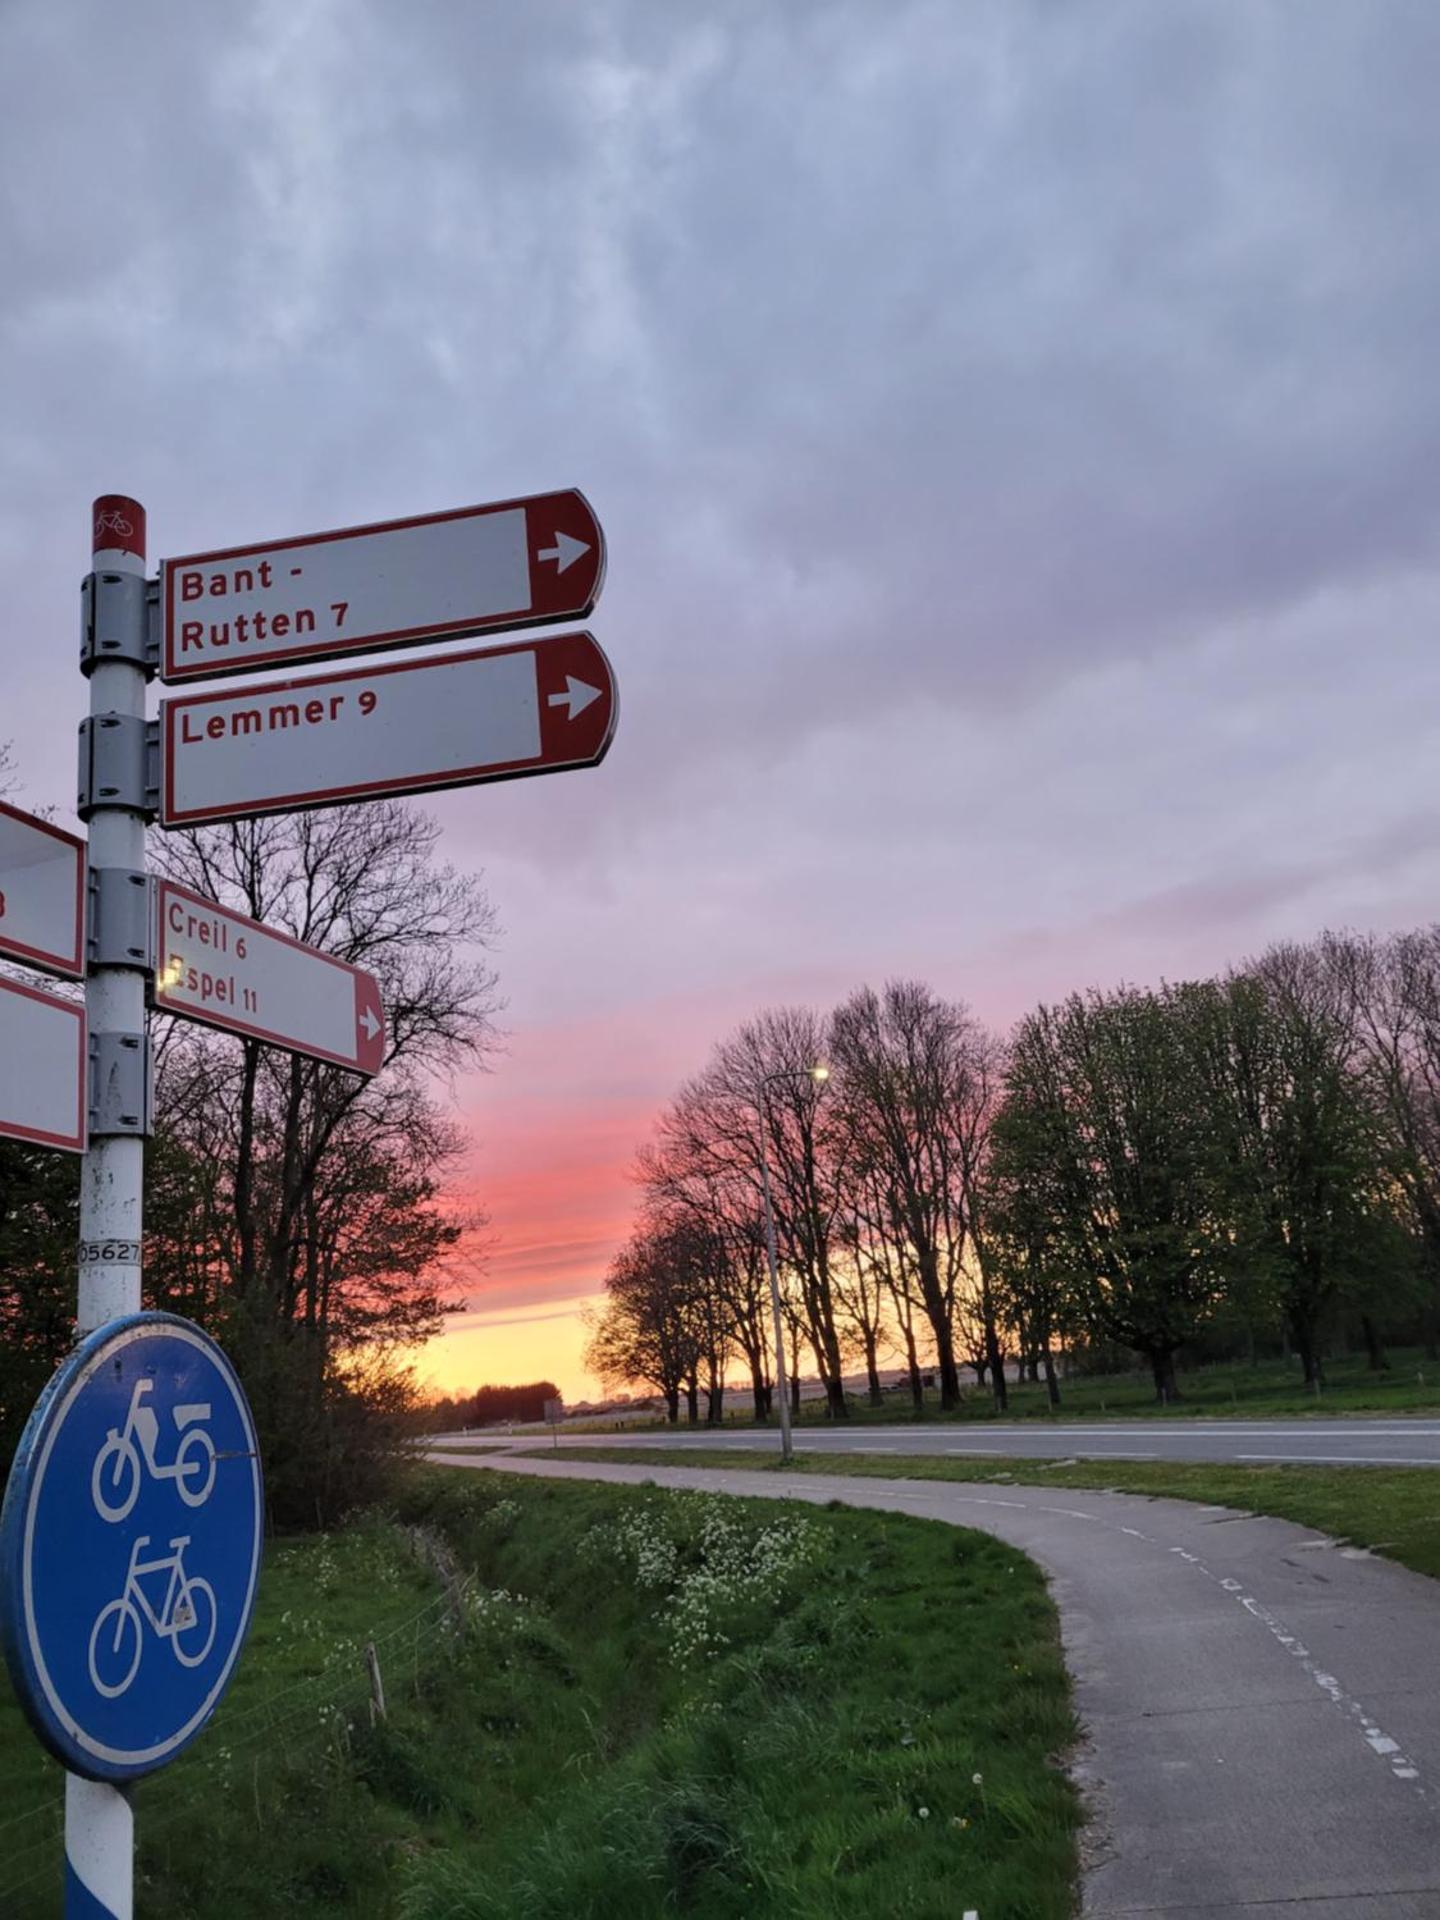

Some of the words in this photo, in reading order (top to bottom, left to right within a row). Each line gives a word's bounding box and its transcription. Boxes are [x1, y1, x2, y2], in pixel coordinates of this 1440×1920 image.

[182, 561, 272, 601] Bant
[182, 609, 315, 652] Rutten
[330, 603, 348, 627] 7
[182, 696, 345, 744] Lemmer
[358, 691, 377, 716] 9
[169, 902, 227, 952] Creil
[236, 938, 246, 960] 6
[243, 988, 257, 1013] 11
